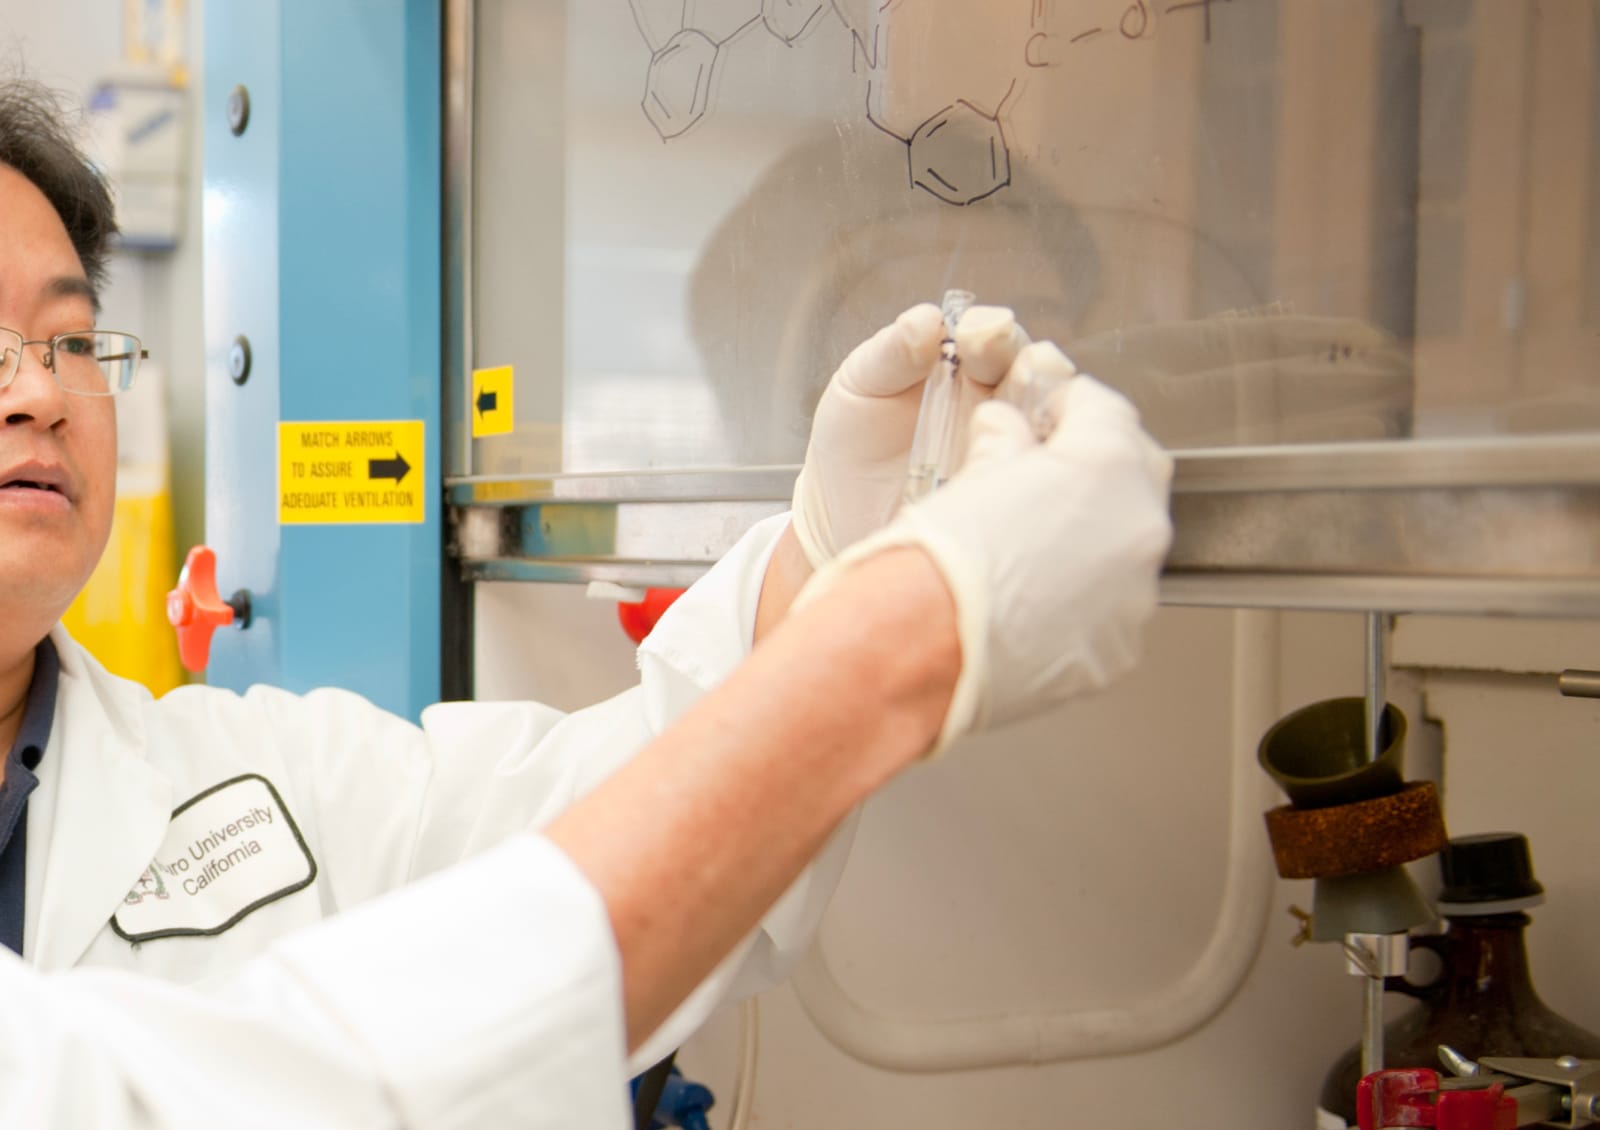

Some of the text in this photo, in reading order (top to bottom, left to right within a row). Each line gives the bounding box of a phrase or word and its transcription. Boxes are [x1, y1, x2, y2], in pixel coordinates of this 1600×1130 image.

[300, 430, 393, 448] MATCH ARROWS
[291, 461, 352, 478] TO ASSURE
[282, 490, 414, 509] ADEQUATE VENTILATION
[188, 806, 273, 861] University
[183, 840, 262, 897] California
